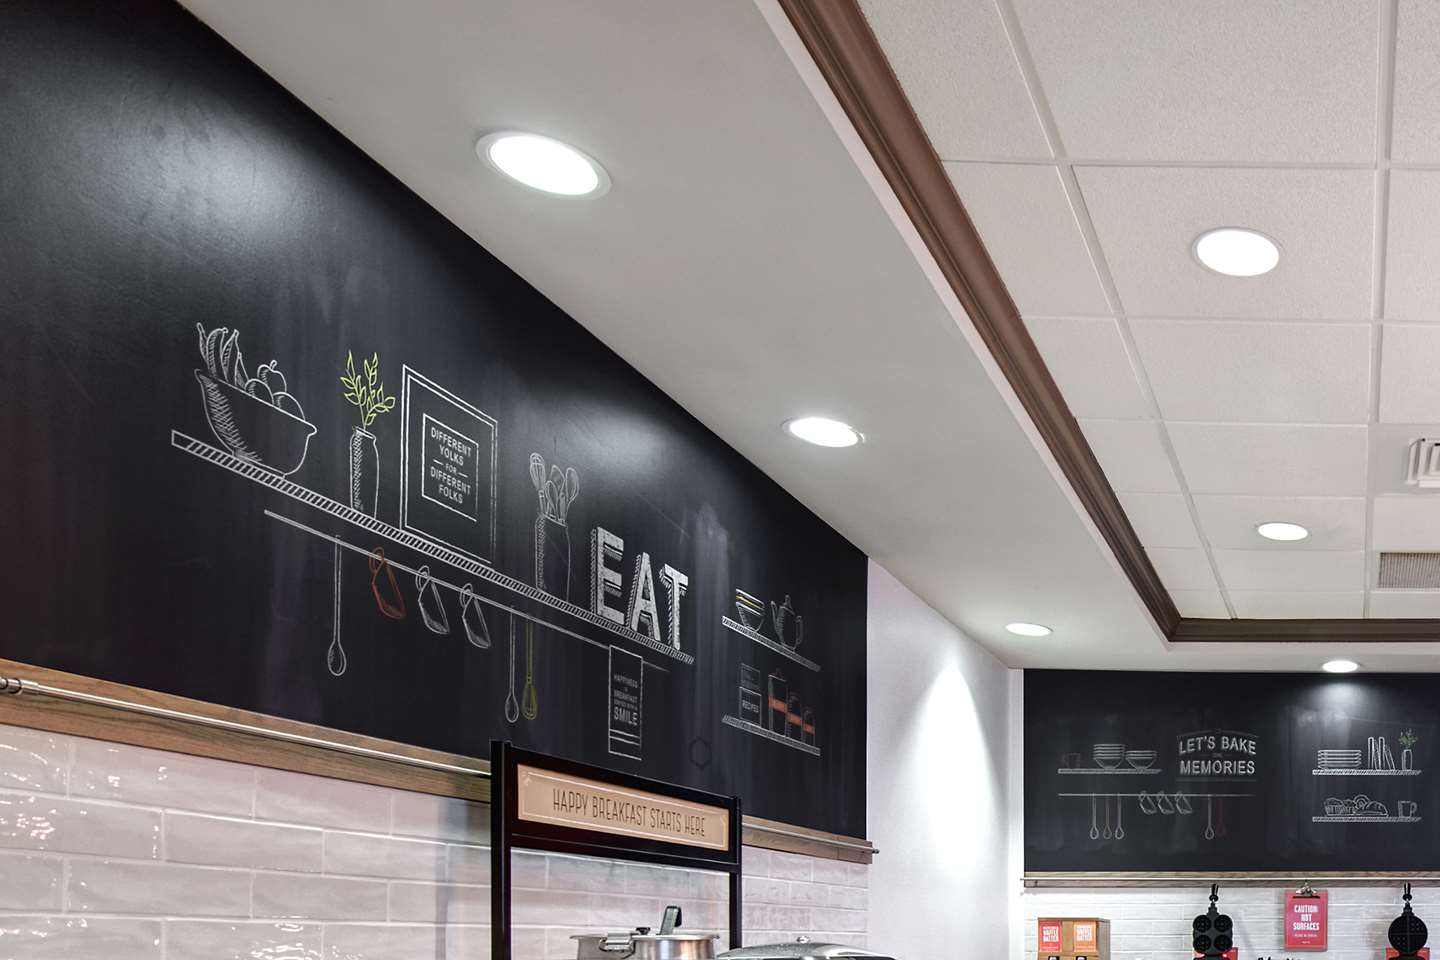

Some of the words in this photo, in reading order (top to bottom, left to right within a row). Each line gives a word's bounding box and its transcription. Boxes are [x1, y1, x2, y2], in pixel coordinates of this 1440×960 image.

[431, 427, 471, 457] DIFFERENT
[440, 444, 464, 466] YOLKS
[446, 464, 456, 475] FOR
[430, 466, 471, 495] DIFFERENT
[439, 484, 463, 504] FOLKS
[590, 526, 689, 650] EAT
[614, 706, 638, 726] SMILE
[1179, 736, 1216, 755] LET'S
[1222, 736, 1256, 754] BAKE
[1180, 760, 1255, 774] MEMORIES
[552, 788, 588, 816] HAPPY
[592, 796, 646, 827] BREAKFAST
[650, 807, 682, 832] STARTS
[684, 815, 705, 837] HERE
[1294, 904, 1318, 912] CAUTION
[1301, 914, 1312, 922] HOT
[1292, 922, 1320, 930] SURFACES
